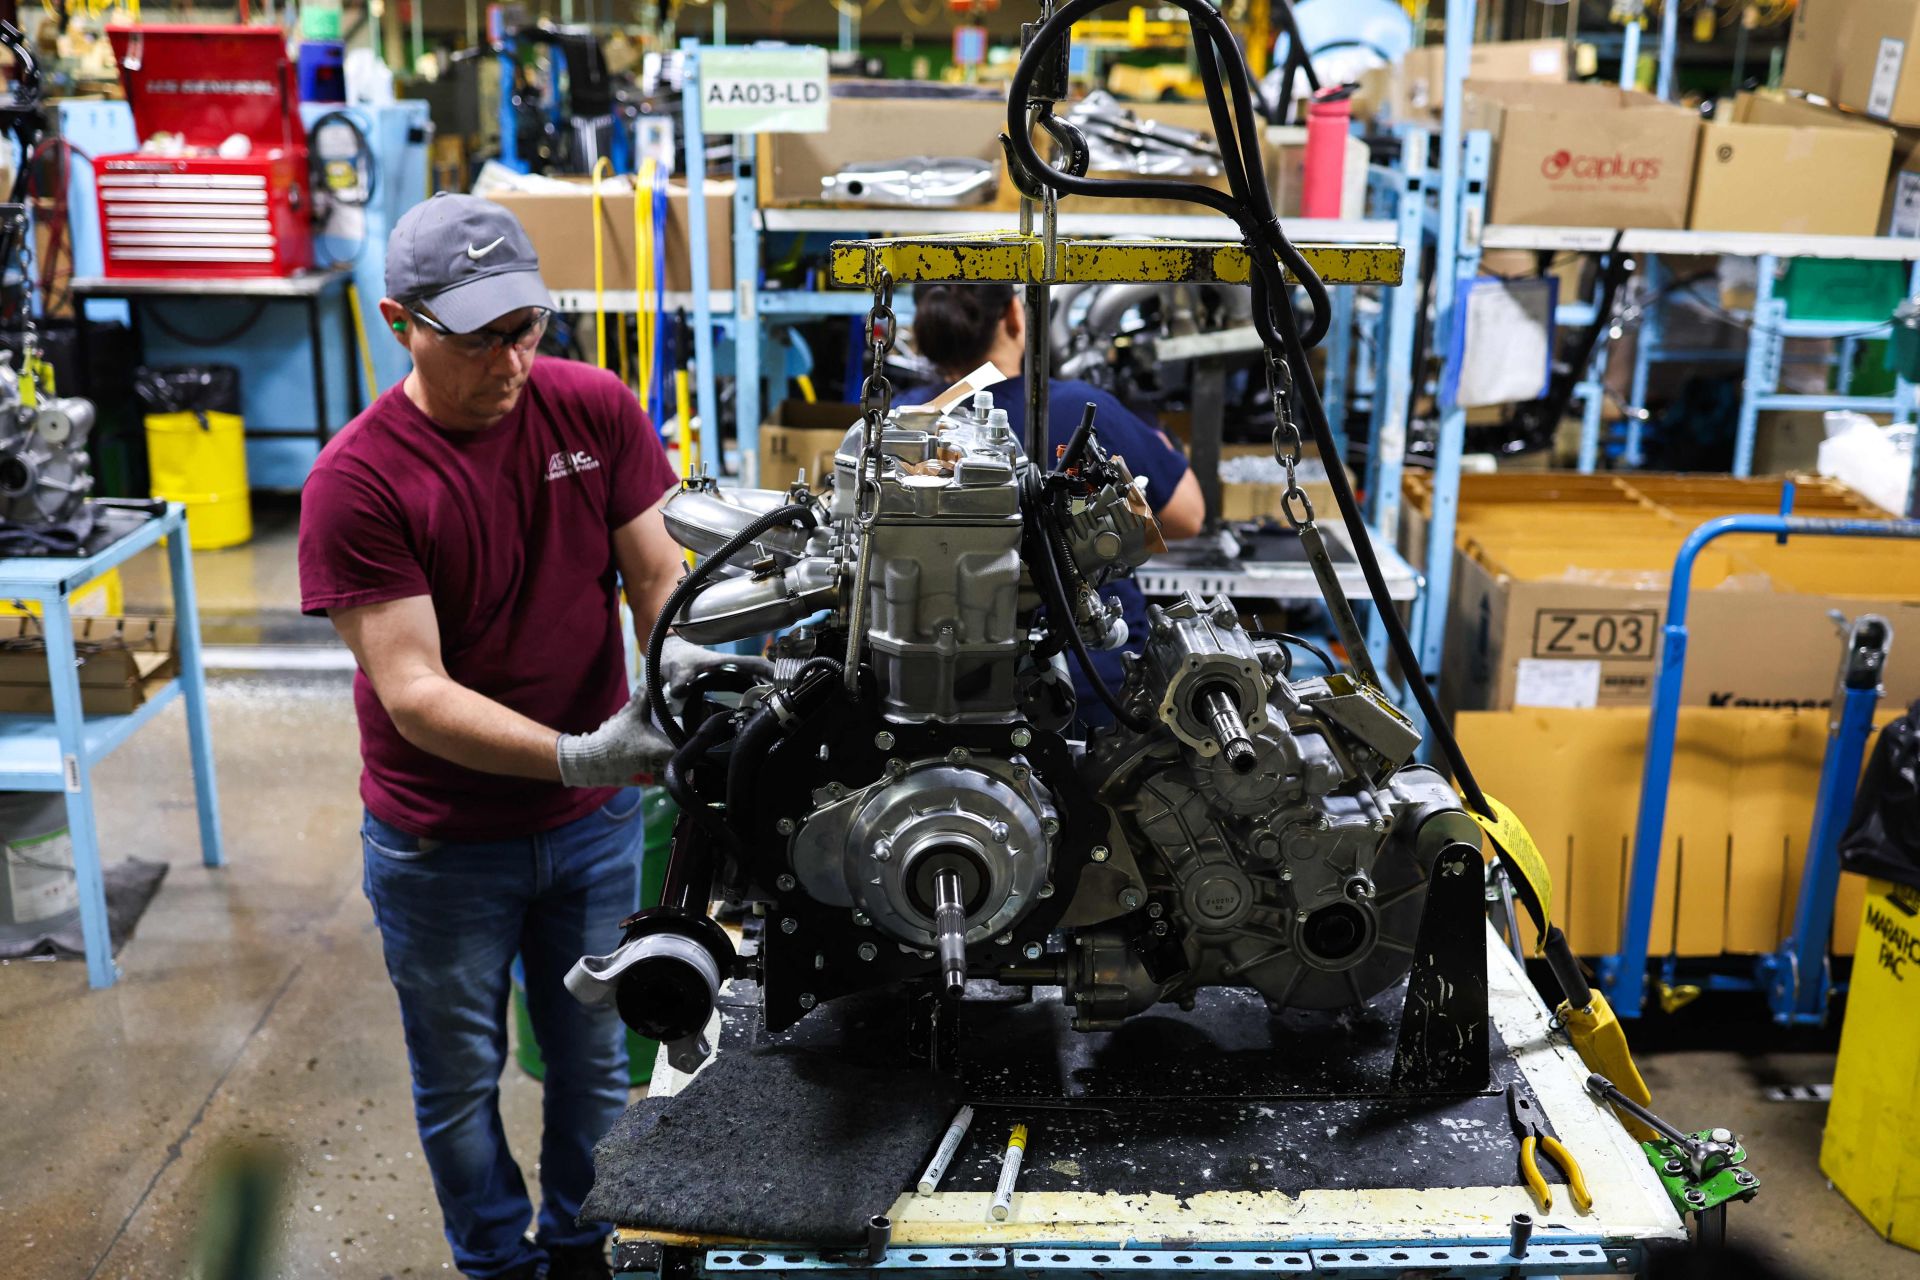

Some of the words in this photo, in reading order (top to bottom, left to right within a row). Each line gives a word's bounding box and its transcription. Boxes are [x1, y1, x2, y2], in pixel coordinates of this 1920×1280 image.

[708, 82, 821, 103] AA03-LD
[1546, 616, 1643, 654] Z-03
[1879, 943, 1905, 981] PAC
